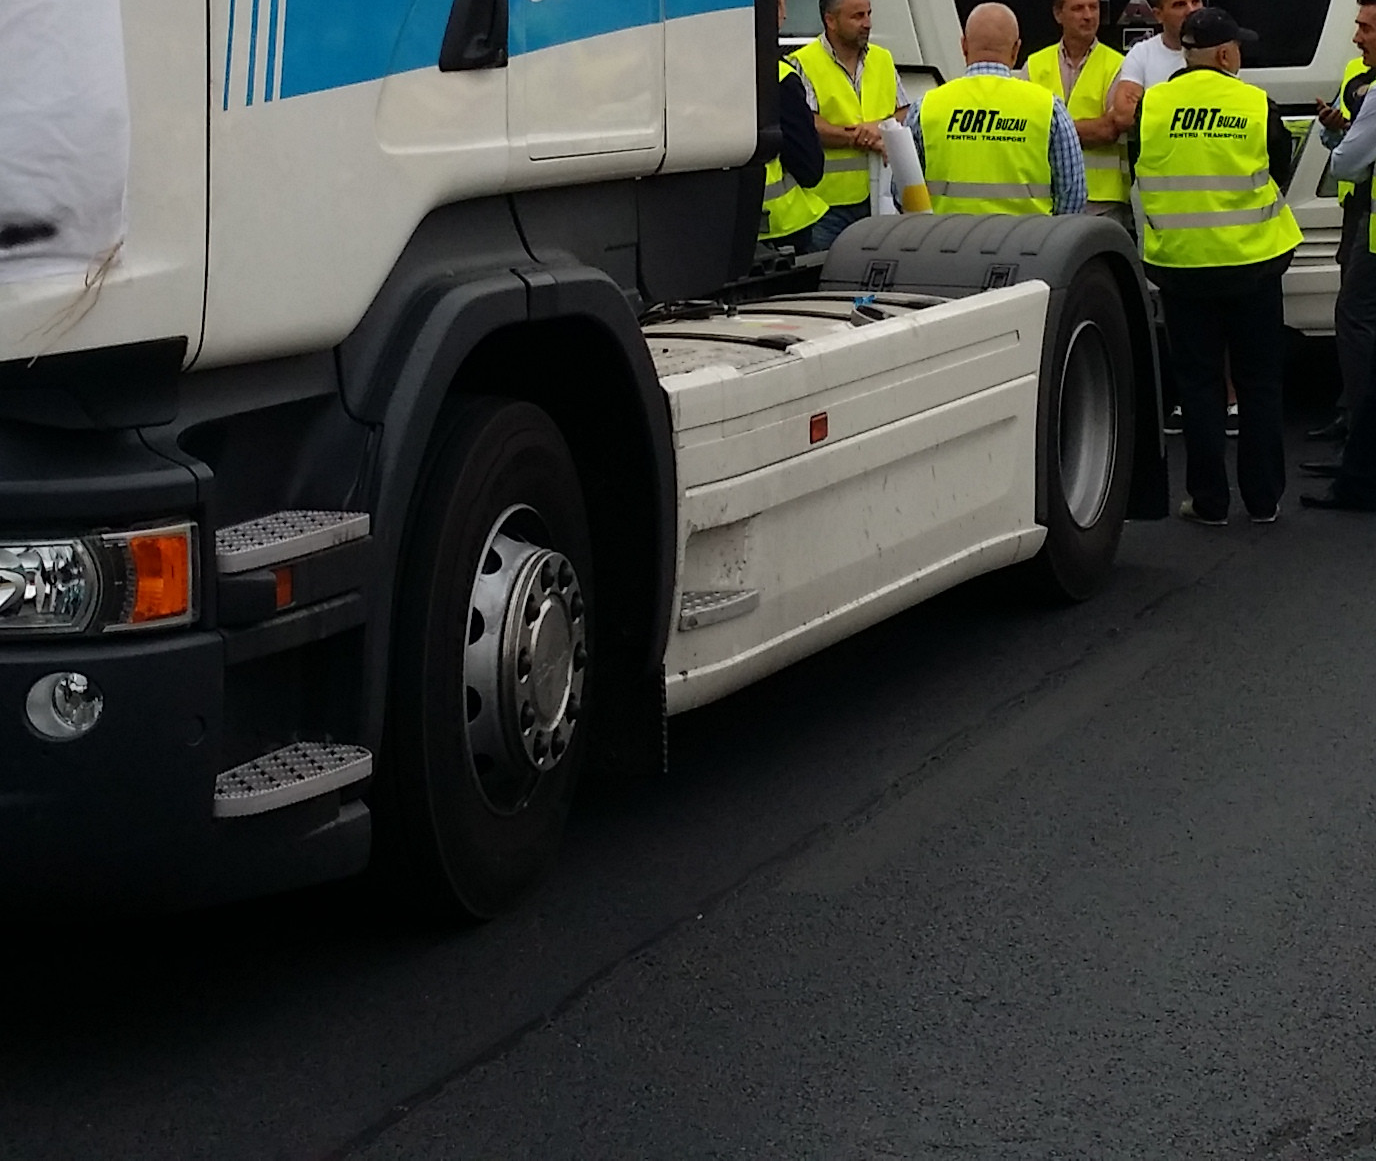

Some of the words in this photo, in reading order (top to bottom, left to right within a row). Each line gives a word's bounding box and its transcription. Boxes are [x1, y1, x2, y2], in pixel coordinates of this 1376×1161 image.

[947, 109, 1000, 133] FORT
[995, 118, 1028, 132] BUZAU
[1170, 107, 1222, 131] FORT
[1216, 115, 1248, 129] BUZAU
[981, 135, 1027, 143] TRANSPORT
[1202, 132, 1247, 140] TRANSPORT
